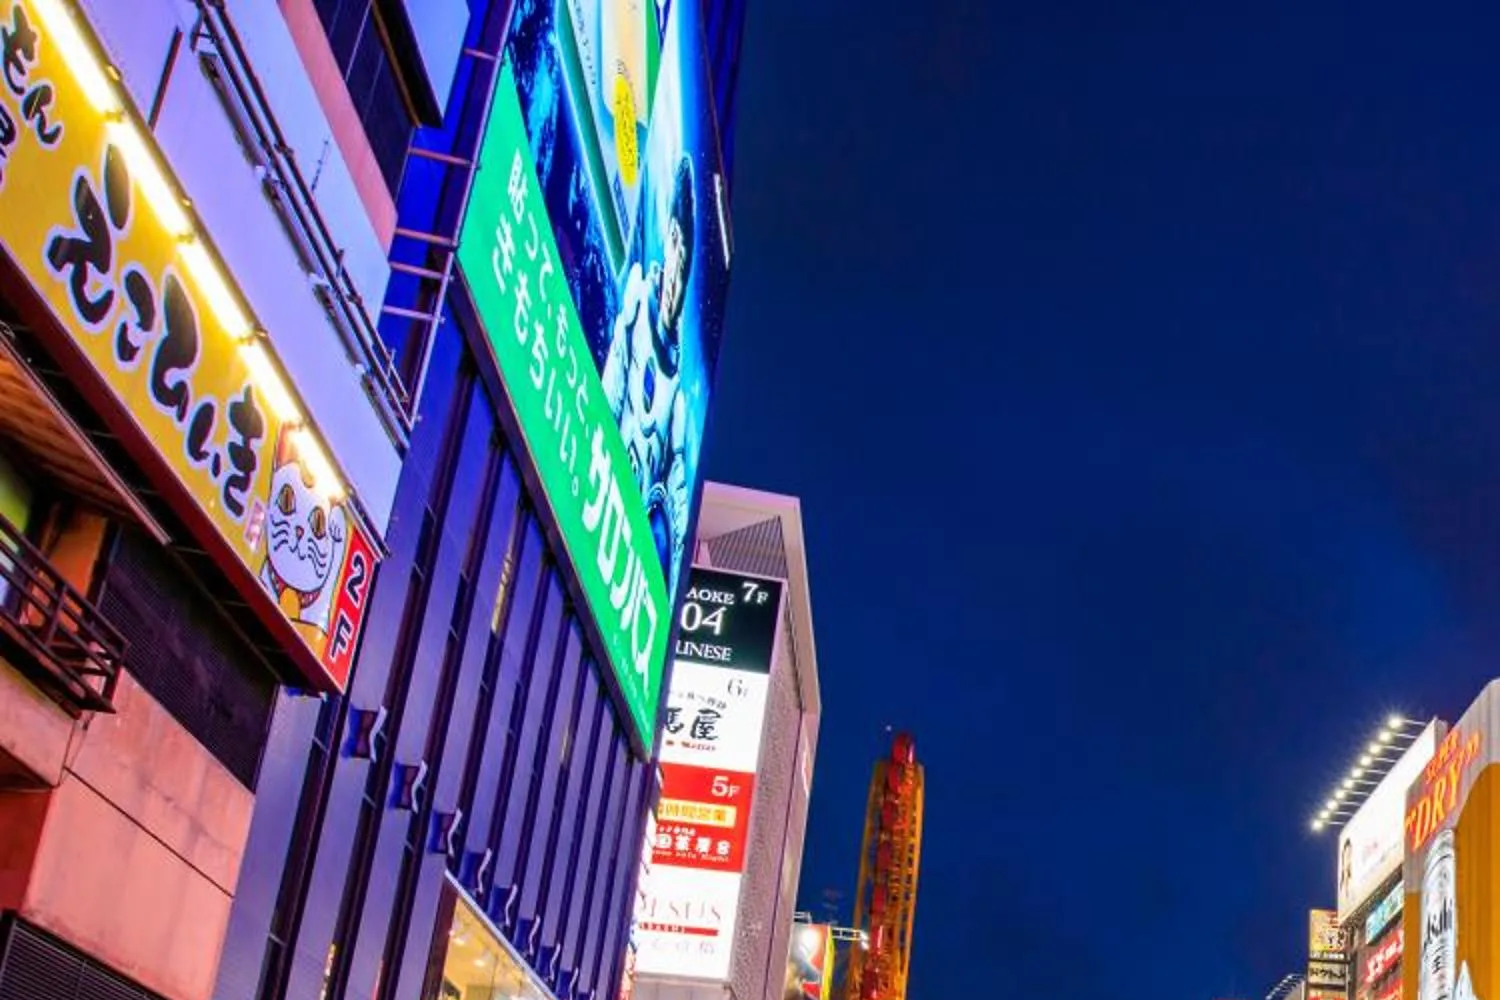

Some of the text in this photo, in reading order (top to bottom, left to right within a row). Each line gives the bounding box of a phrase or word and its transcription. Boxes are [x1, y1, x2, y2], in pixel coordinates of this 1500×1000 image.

[582, 422, 653, 700] サロンパス
[329, 563, 367, 663] 2F
[742, 582, 769, 605] 7F
[711, 775, 741, 799] 5F
